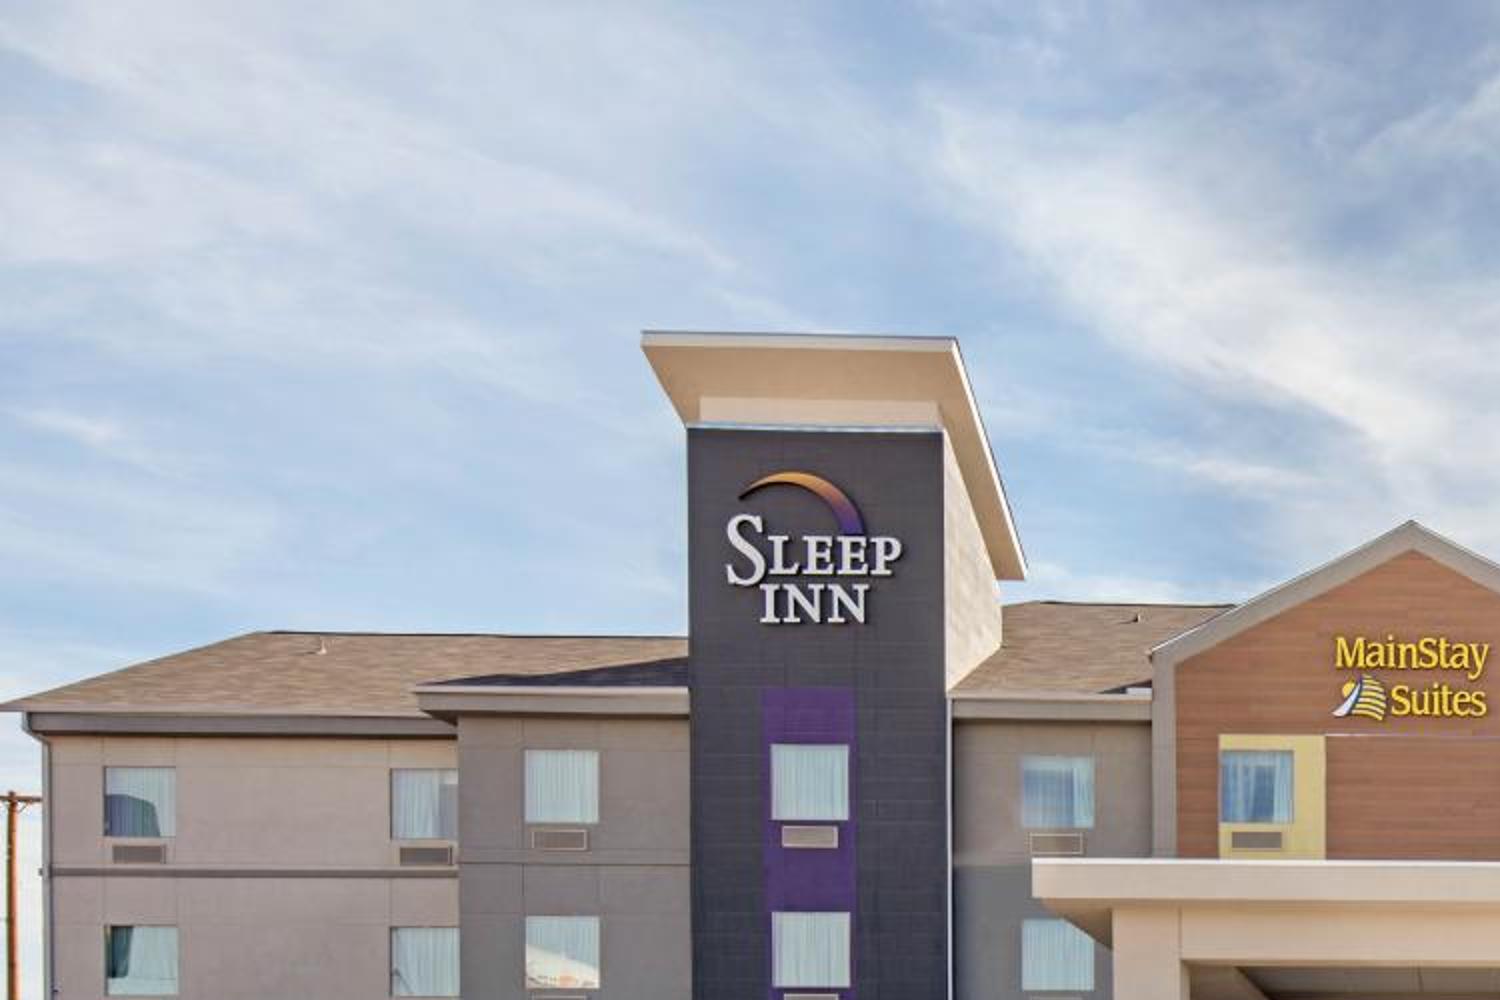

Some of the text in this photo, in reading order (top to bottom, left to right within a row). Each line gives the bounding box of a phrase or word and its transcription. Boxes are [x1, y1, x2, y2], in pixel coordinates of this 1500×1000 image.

[726, 513, 902, 587] SLEEP
[759, 583, 870, 624] INN
[1335, 633, 1489, 680] MainStay
[1390, 682, 1487, 717] Suites
